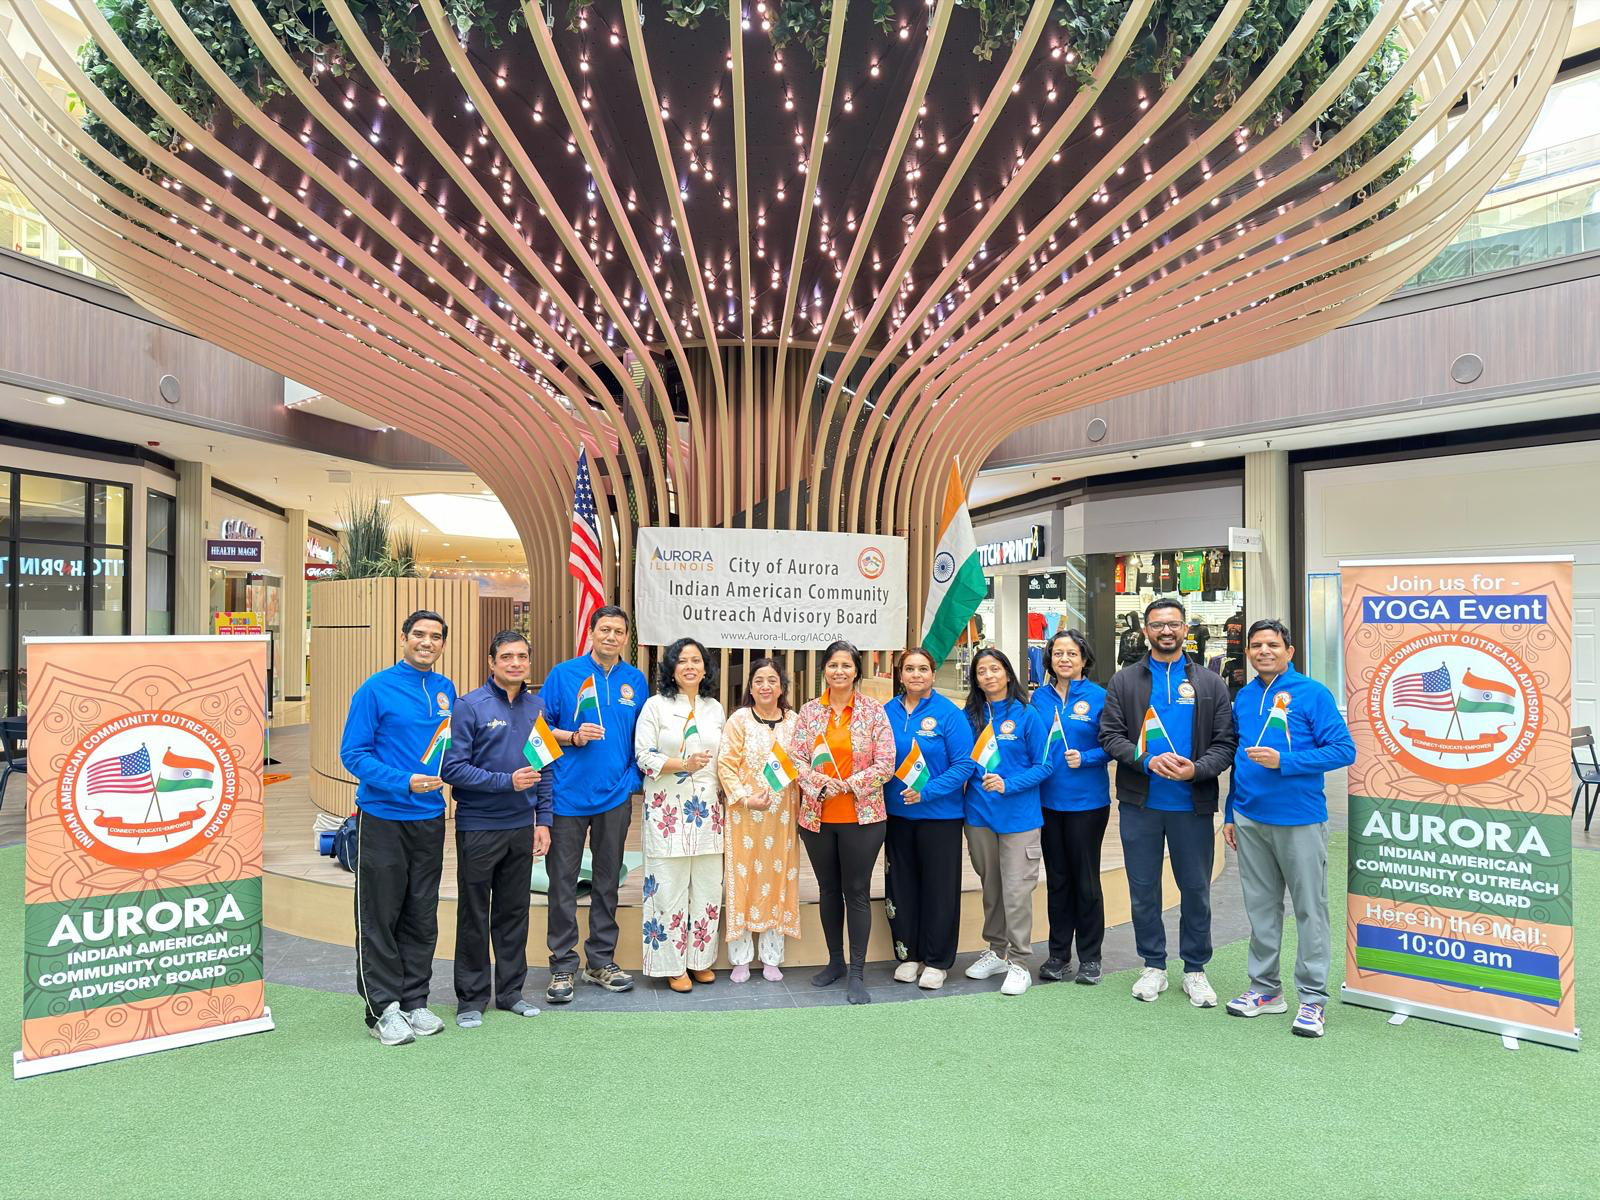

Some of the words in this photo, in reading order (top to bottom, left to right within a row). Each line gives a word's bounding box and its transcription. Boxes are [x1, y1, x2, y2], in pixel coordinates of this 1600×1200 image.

[211, 546, 236, 556] HEALTH
[238, 547, 258, 556] MAGIC
[650, 562, 714, 572] ILLINOIS
[651, 546, 713, 562] AURORA
[729, 557, 760, 576] City
[766, 556, 782, 574] of
[788, 559, 839, 575] Aurora
[669, 580, 720, 597] Indian
[726, 582, 801, 599] American
[808, 584, 889, 604] Community
[1386, 575, 1432, 592] Join
[1439, 577, 1465, 591] us
[1471, 574, 1505, 590] for
[683, 605, 755, 622] Outreach
[762, 607, 831, 627] Advisory
[837, 609, 877, 624] Board
[1368, 599, 1450, 620] YOGA
[1459, 599, 1544, 620] Event
[720, 632, 843, 644] www.Aurora-IL.org/IACOAB
[1389, 633, 1457, 665] COMMUNITY
[1461, 634, 1522, 672] OUTREACH
[1370, 664, 1392, 718] AMERICAN
[1517, 672, 1539, 731] ADVISORY
[83, 713, 159, 749] COMMUNITY
[162, 714, 221, 748] OUTREACH
[1375, 722, 1401, 755] INDIAN
[1505, 731, 1535, 764] BOARD
[61, 750, 87, 810] AMERICAN
[216, 747, 236, 801] ADVISORY
[63, 814, 95, 848] INDIAN
[204, 802, 232, 838] BOARD
[1361, 810, 1551, 857] AURORA
[1356, 859, 1458, 882] COMMUNITY
[1461, 872, 1559, 895] OUTREACH
[1379, 845, 1436, 863] INDIAN
[1439, 853, 1532, 875] AMERICAN
[1380, 878, 1464, 902] ADVISORY
[1468, 888, 1531, 909] BOARD
[47, 893, 245, 947] AURORA
[1365, 903, 1417, 925] Here
[1424, 911, 1443, 929] in
[1449, 916, 1489, 936] the
[1492, 924, 1547, 946] Mall:
[67, 944, 132, 965] INDIAN
[136, 931, 228, 956] AMERICAN
[1397, 933, 1466, 960] 10:00
[1473, 949, 1513, 968] am
[38, 960, 154, 987] COMMUNITY
[159, 944, 251, 968] OUTREACH
[68, 974, 161, 1001] ADVISORY
[166, 965, 227, 985] BOARD
